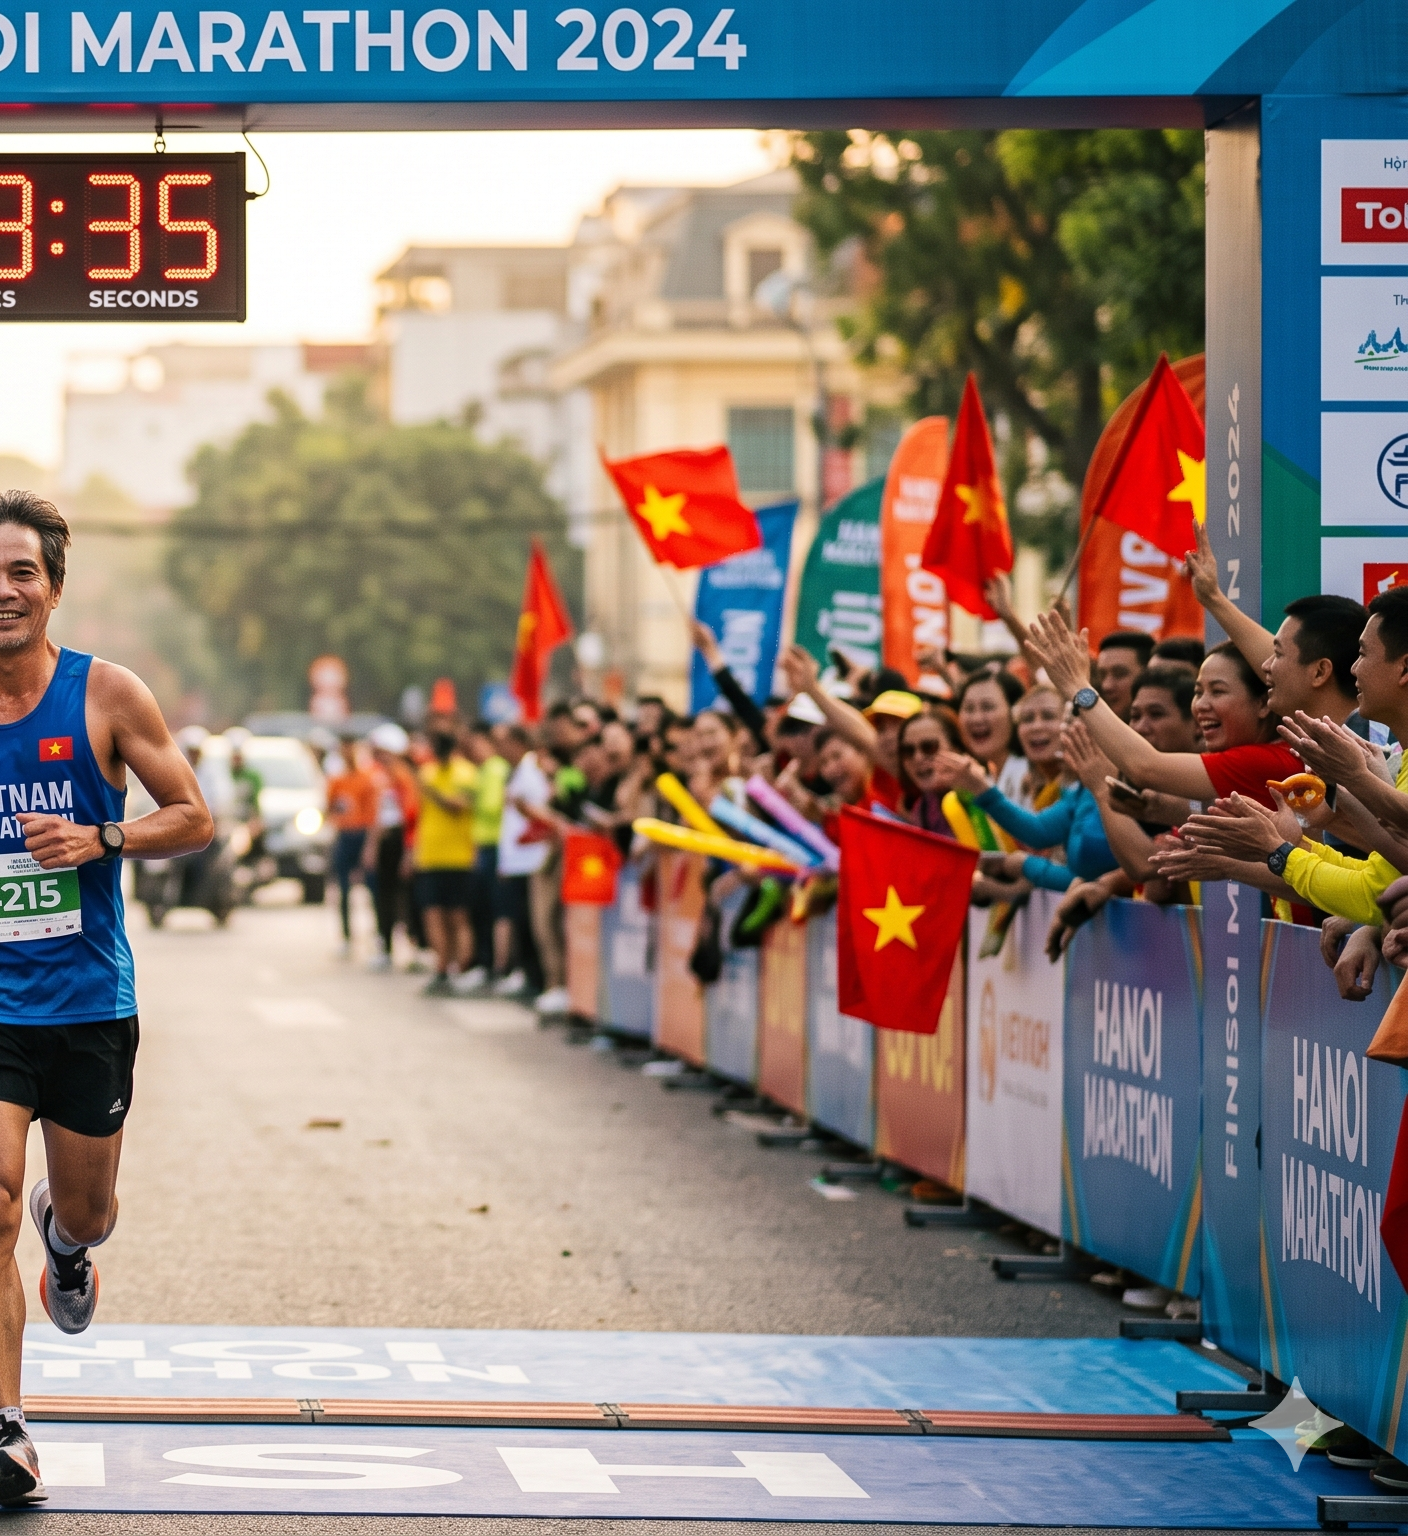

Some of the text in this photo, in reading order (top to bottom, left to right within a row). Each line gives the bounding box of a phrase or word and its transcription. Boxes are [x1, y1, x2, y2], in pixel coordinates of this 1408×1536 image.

[71, 10, 528, 73] MARATHON
[554, 8, 747, 70] 2024
[88, 289, 200, 308] SECONDS
[1227, 382, 1240, 538] 2024
[1093, 979, 1163, 1080] HANOI
[1225, 956, 1240, 1179] FINISOI
[1083, 1071, 1173, 1191] MARATHON
[1293, 1036, 1368, 1167] HANOI
[1281, 1152, 1382, 1313] MARATHON
